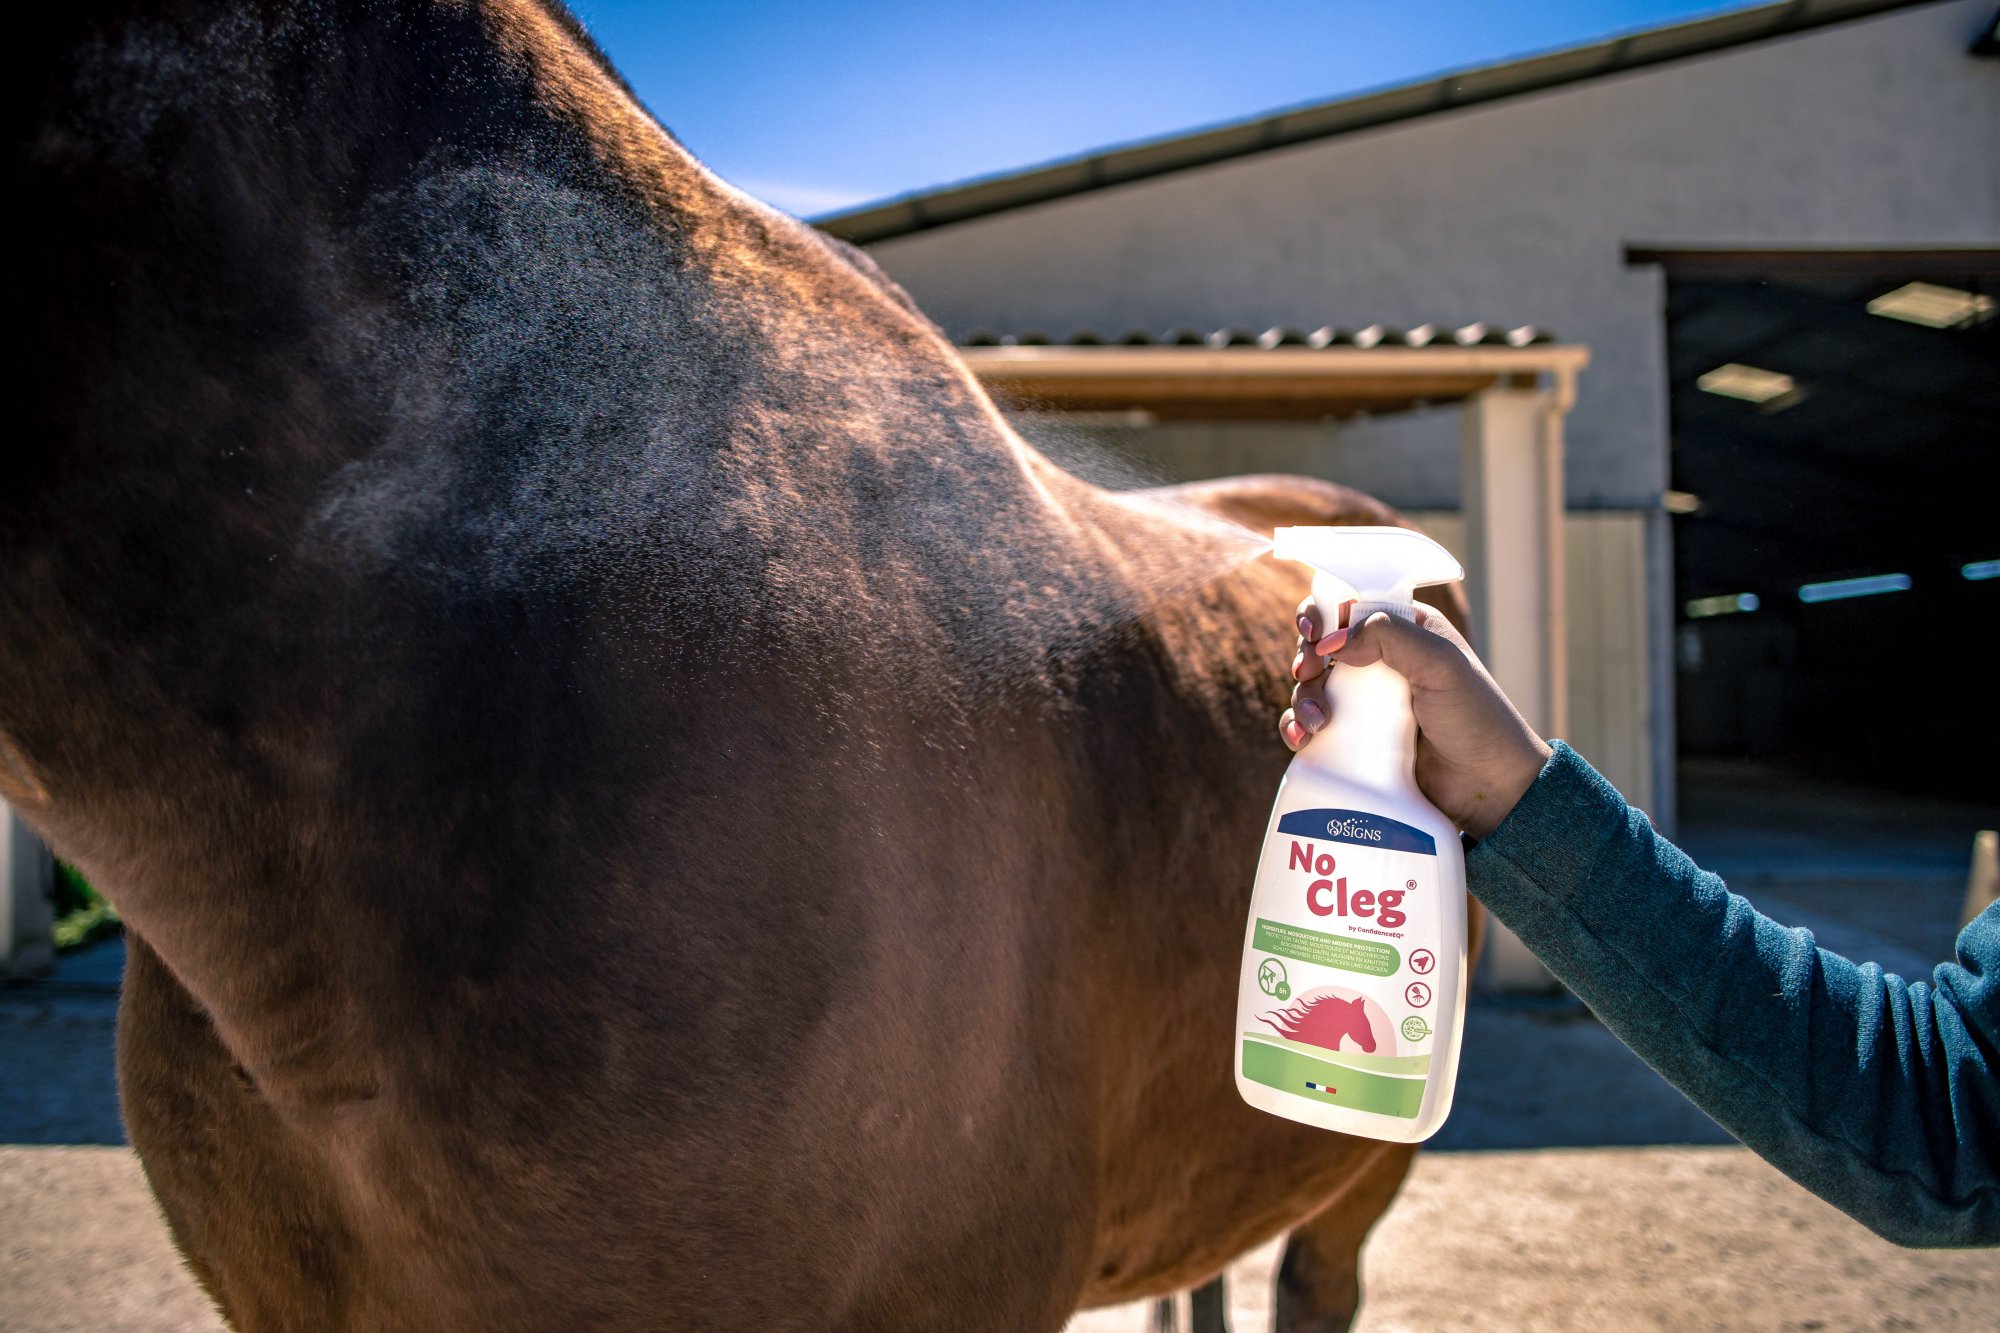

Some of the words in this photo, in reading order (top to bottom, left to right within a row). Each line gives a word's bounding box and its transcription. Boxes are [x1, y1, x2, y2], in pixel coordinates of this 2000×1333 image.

[1289, 840, 1336, 876] No
[1266, 930, 1292, 942] PROTECTION
[1309, 941, 1341, 952] MOUSTIQUES
[1349, 950, 1389, 961] MOUCHERONS
[1288, 930, 1319, 941] MOSQUITOES
[1319, 937, 1331, 945] AND
[1332, 940, 1353, 948] MIDGES
[1354, 944, 1390, 954] PROTECTION
[1279, 987, 1287, 995] 5h
